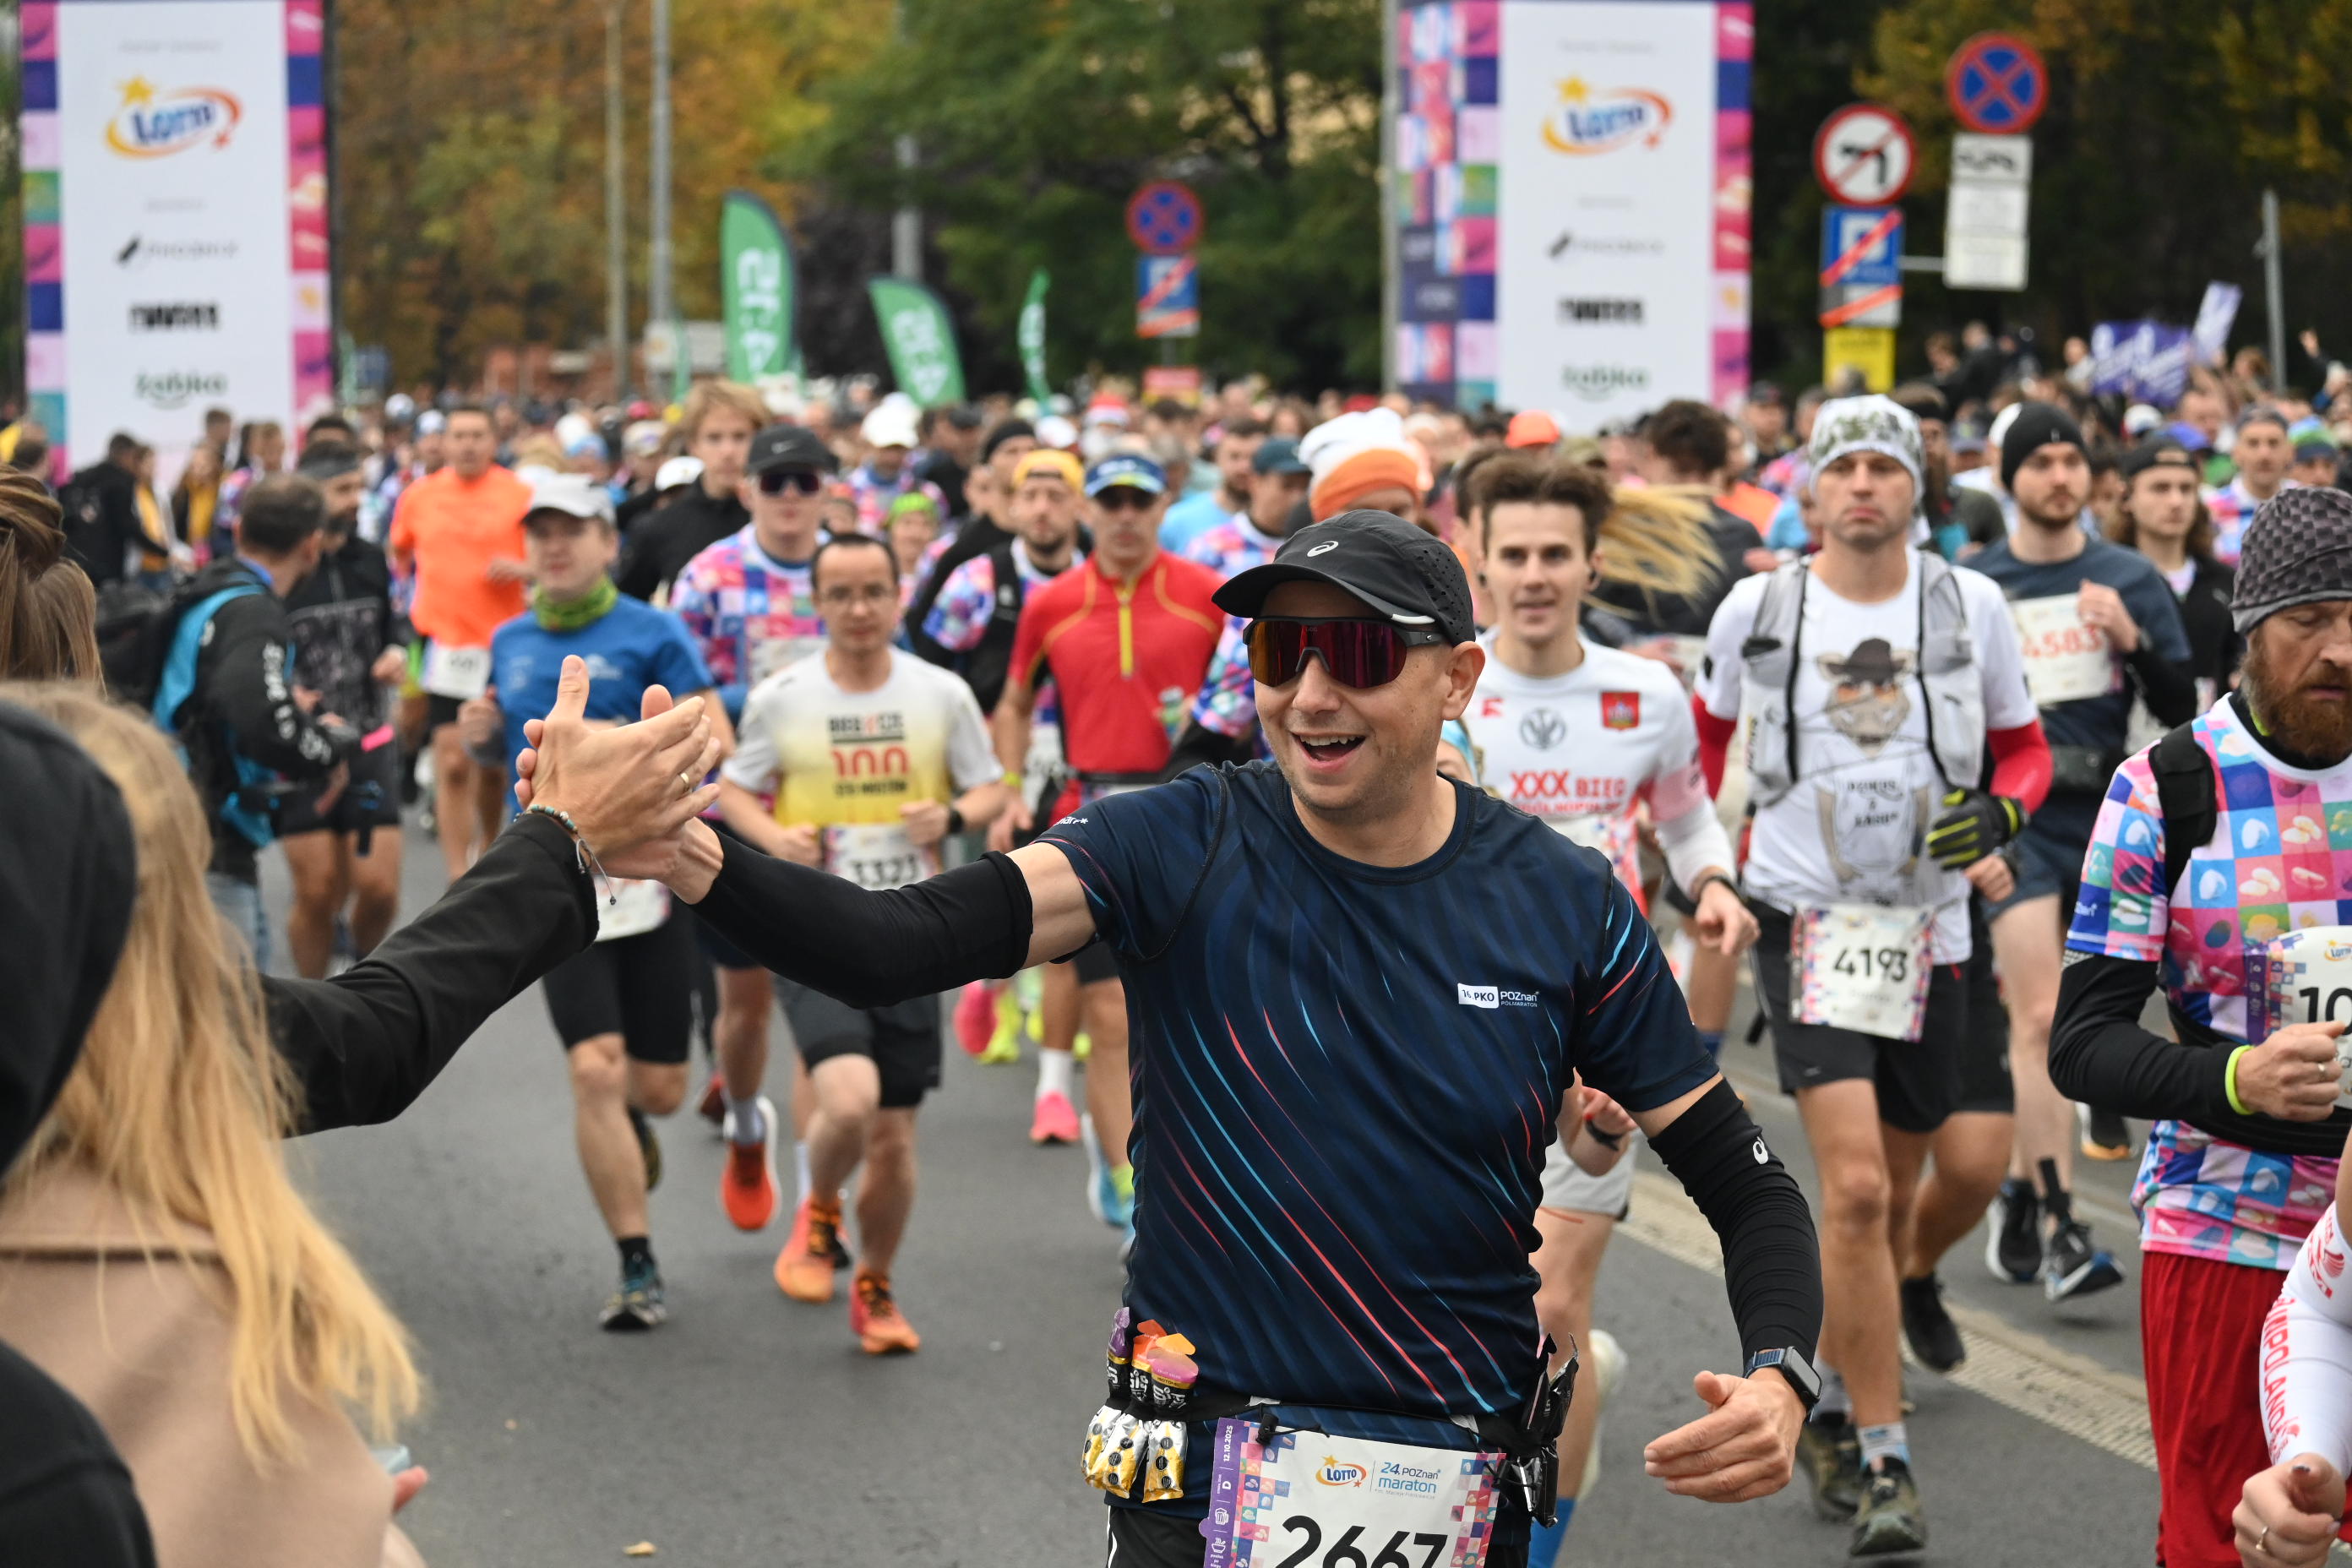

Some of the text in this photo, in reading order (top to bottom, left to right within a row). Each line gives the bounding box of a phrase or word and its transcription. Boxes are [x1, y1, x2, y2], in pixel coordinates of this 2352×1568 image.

[1510, 770, 1569, 800] XXX
[1834, 946, 1908, 983] 4193
[1474, 992, 1494, 1002] PKO
[1222, 1425, 1233, 1462] 12.10.2025
[1326, 1467, 1357, 1482] LOTTO
[1380, 1462, 1401, 1476] 24.
[1222, 1480, 1232, 1490] D
[1378, 1477, 1437, 1494] maraton
[1275, 1515, 1448, 1568] 2667
